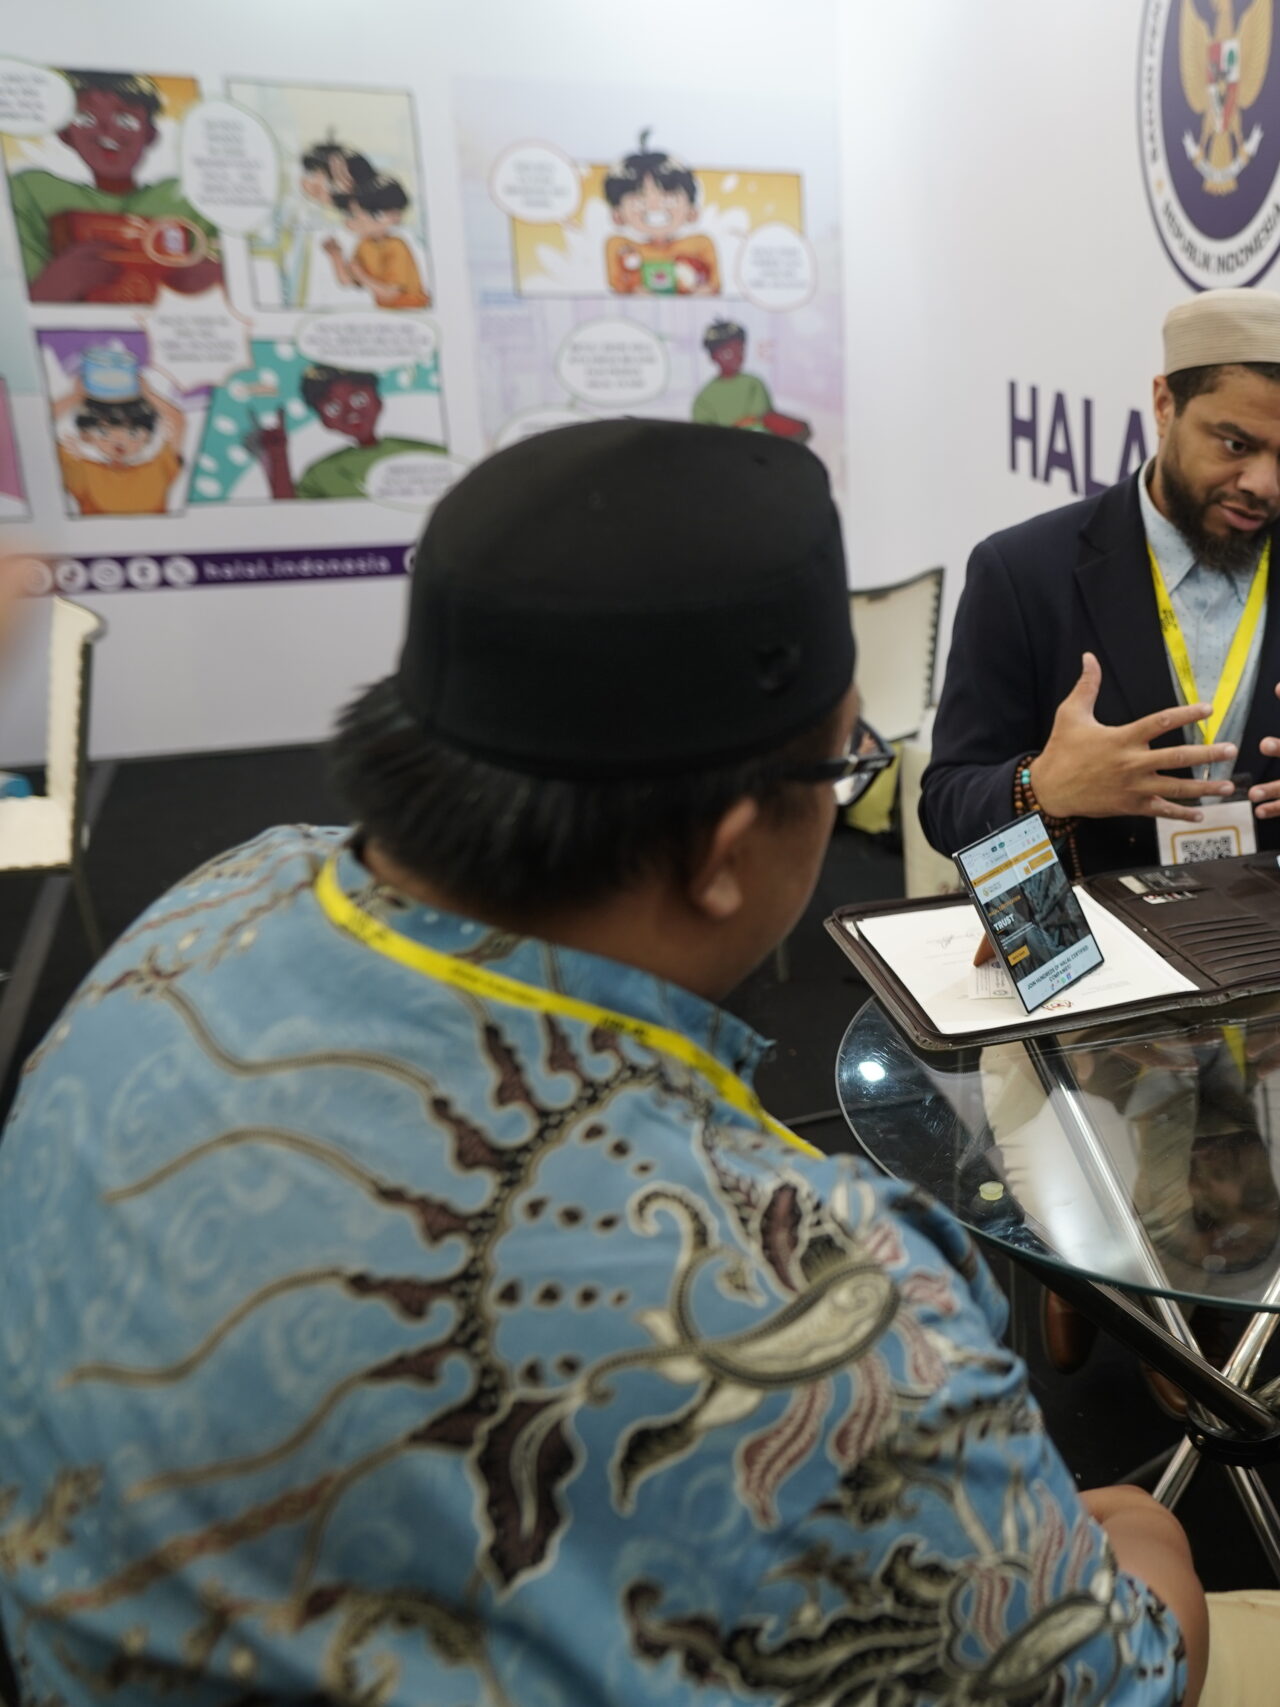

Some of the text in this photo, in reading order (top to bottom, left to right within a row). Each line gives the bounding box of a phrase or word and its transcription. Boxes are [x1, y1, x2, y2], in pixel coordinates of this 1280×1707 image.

[1009, 380, 1148, 497] HALA
[203, 553, 391, 580] halal.indonesia
[993, 913, 1015, 931] TRUST
